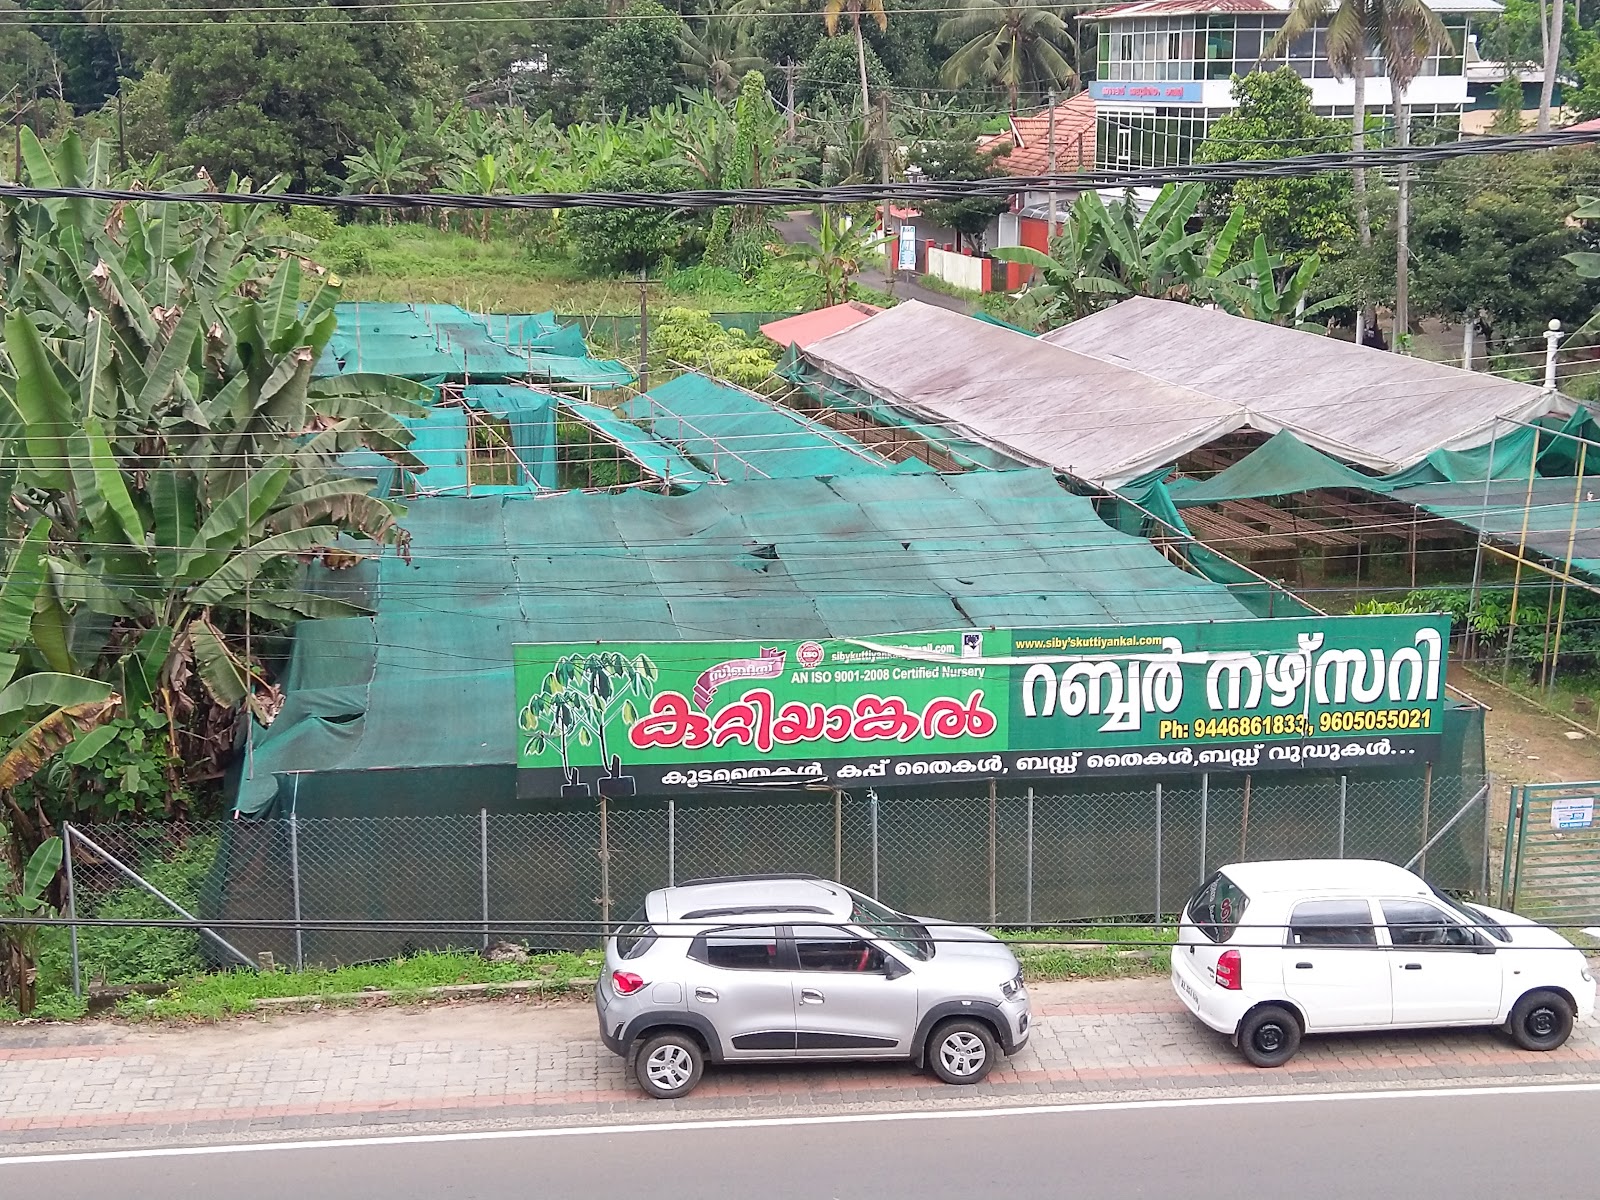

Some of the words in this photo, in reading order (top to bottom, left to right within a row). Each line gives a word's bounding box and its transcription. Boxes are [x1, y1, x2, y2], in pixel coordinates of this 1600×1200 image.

[791, 671, 809, 683] AN
[812, 671, 832, 683] ISO
[834, 668, 889, 682] 9001-2008
[892, 666, 939, 680] Certified
[942, 665, 985, 680] Nursery
[1022, 637, 1184, 732] റബ്ബർ
[628, 687, 998, 753] കുറ്റിയാങ്കൽ
[1159, 720, 1190, 739] Ph:
[1194, 713, 1315, 738] 9446861833,
[1319, 708, 1432, 732] 9605055021
